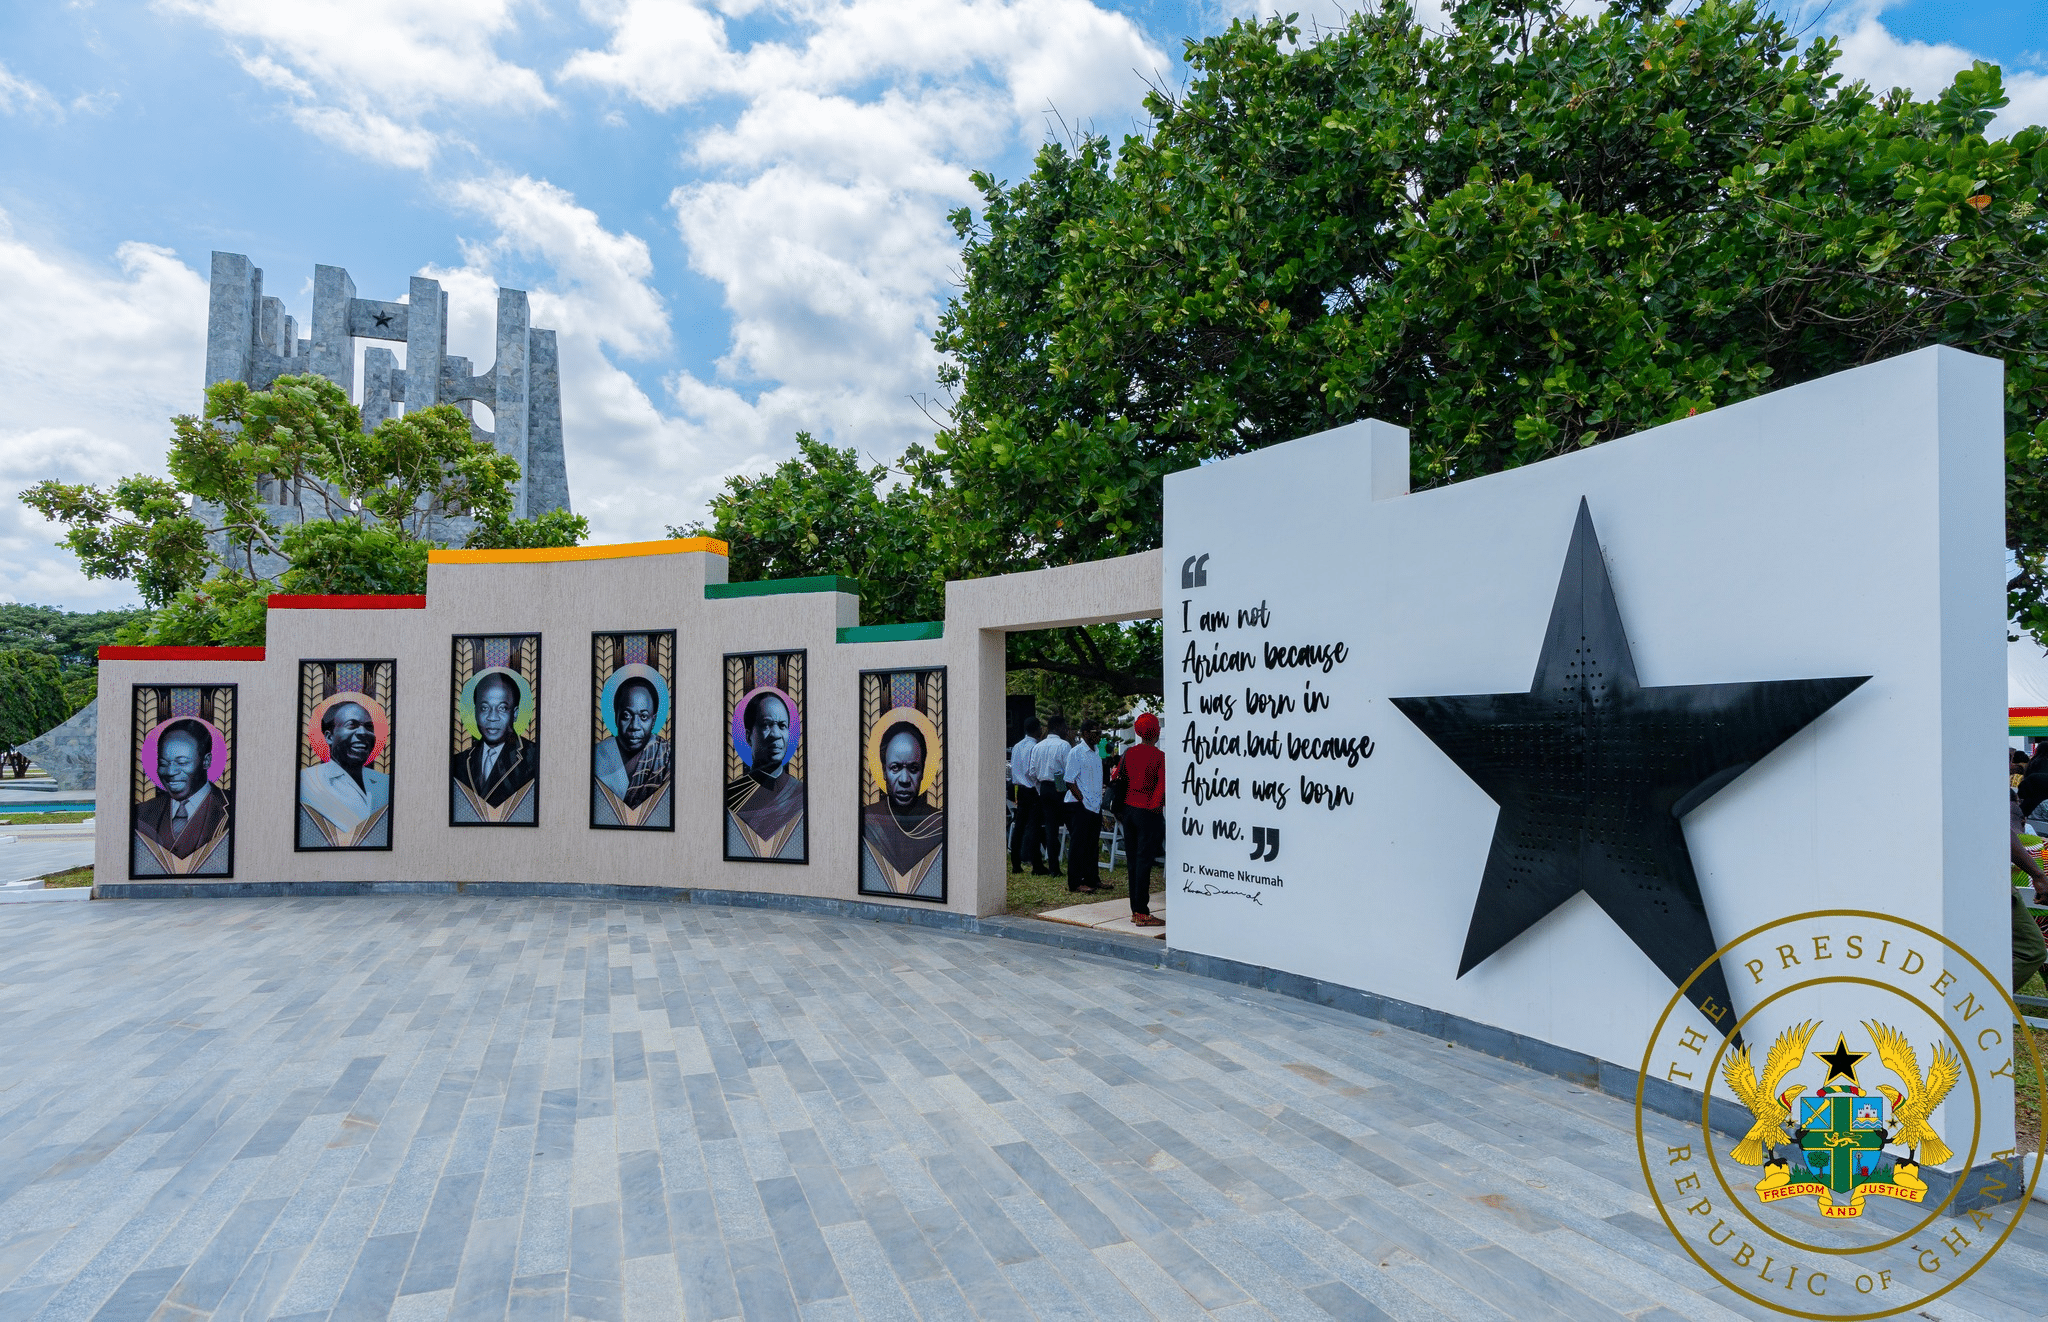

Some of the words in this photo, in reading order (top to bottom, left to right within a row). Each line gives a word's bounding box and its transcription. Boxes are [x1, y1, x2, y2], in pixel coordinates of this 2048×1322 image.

[1182, 600, 1192, 633] I
[1200, 611, 1229, 632] am
[1238, 600, 1271, 629] not
[1182, 640, 1256, 684] African
[1264, 642, 1349, 673] because
[1182, 681, 1192, 714] I
[1200, 694, 1237, 721] was
[1246, 688, 1295, 719] born
[1304, 681, 1329, 713] in
[1288, 733, 1375, 768] because
[1182, 761, 1240, 806] Africa
[1252, 781, 1290, 810] was
[1301, 775, 1353, 810] born
[1182, 807, 1203, 836] in
[1182, 862, 1196, 874] Dr.
[1198, 864, 1235, 880] Kwame
[1237, 870, 1284, 888] Nkrumah
